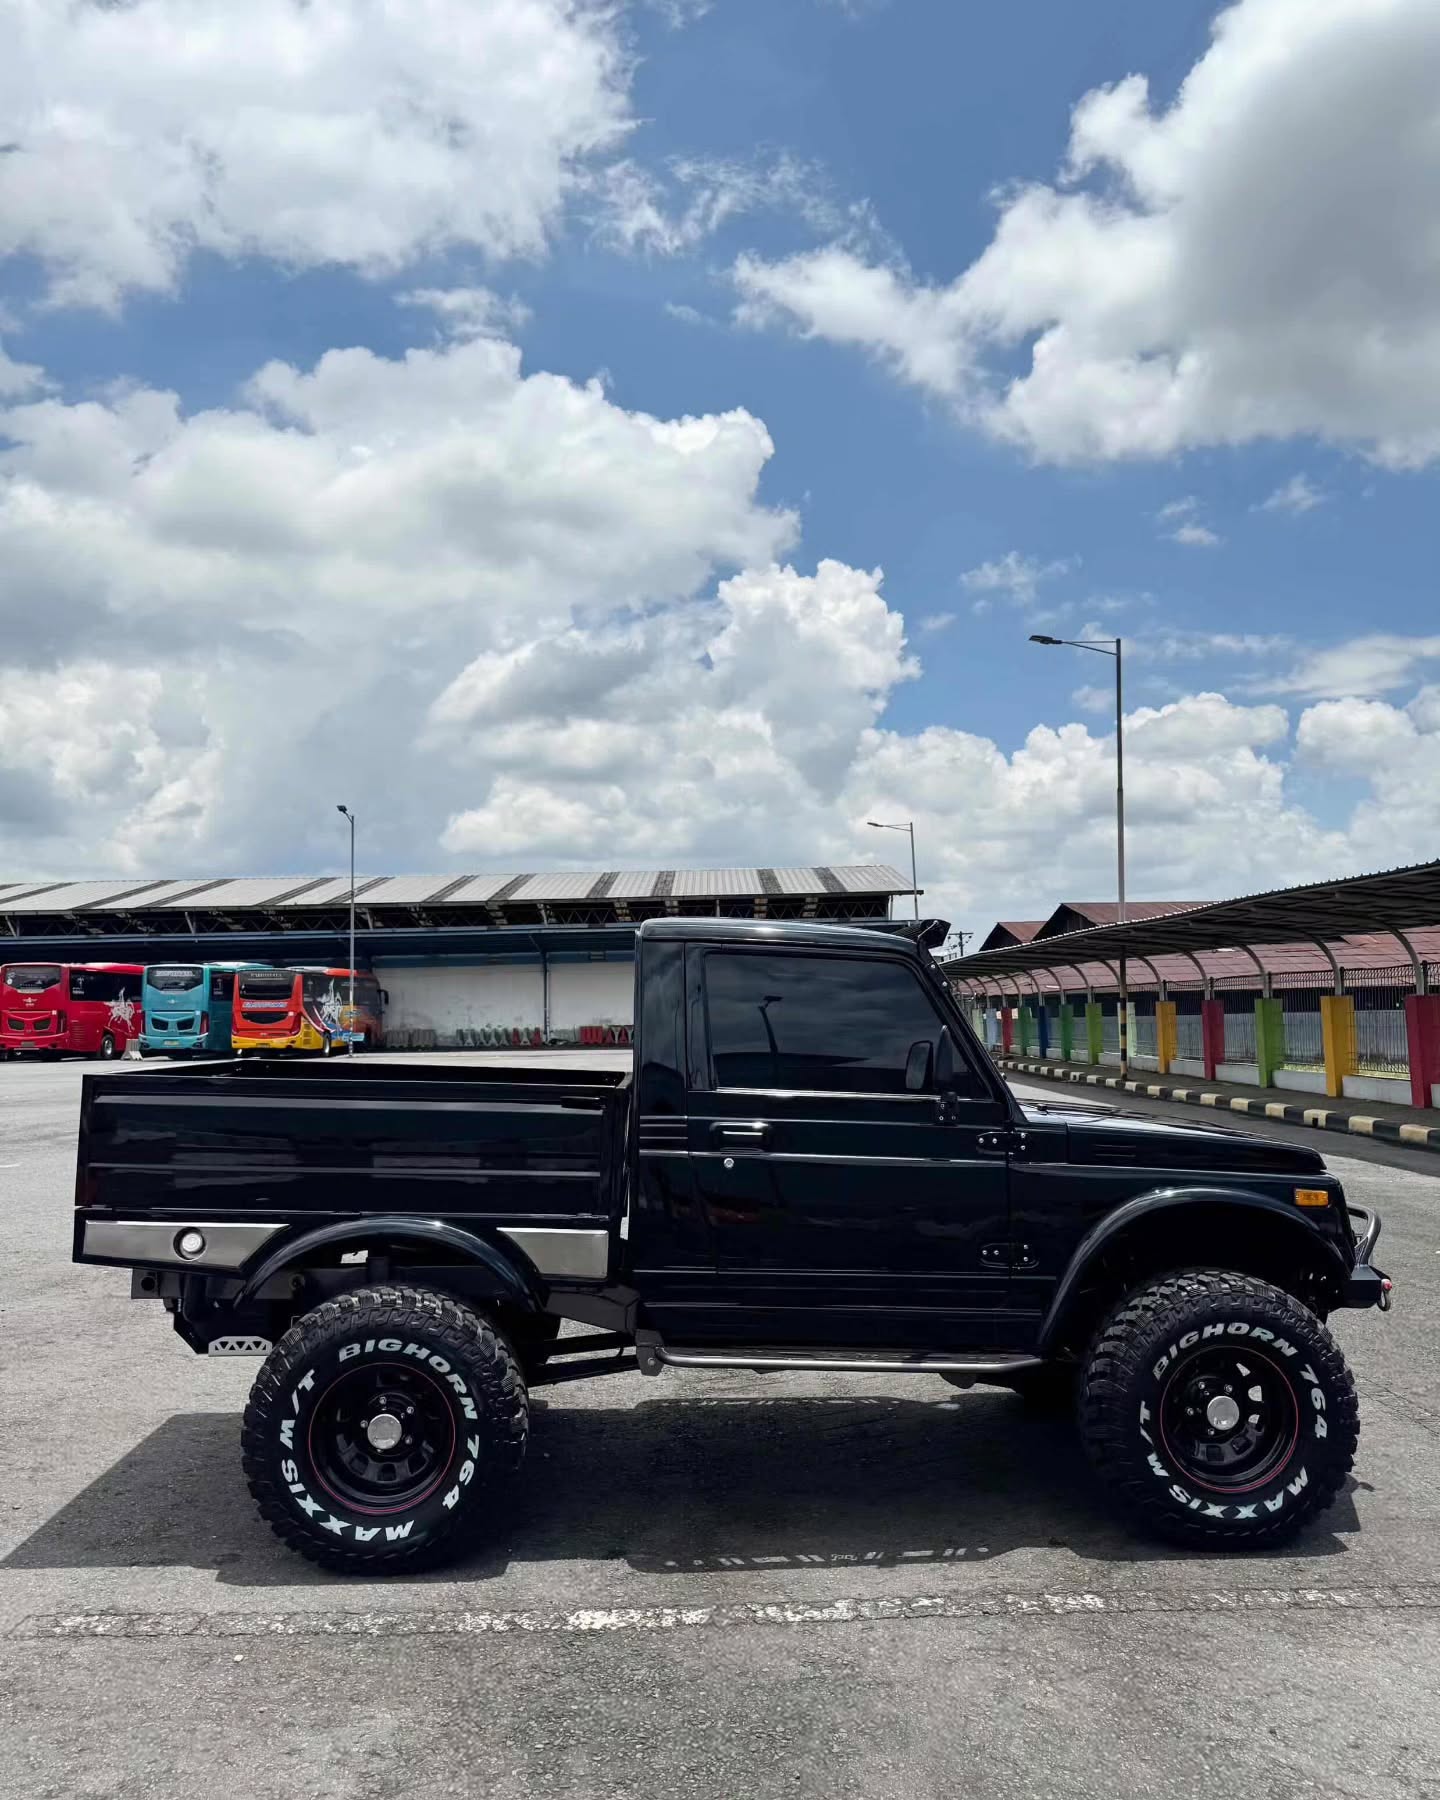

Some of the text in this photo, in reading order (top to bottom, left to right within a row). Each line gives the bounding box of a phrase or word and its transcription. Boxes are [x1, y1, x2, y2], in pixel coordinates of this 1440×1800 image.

[338, 1338, 480, 1510] BIGHORN 764
[1153, 1322, 1328, 1439] BIGHORN 764
[281, 1458, 415, 1542] MAXXIS
[1168, 1466, 1309, 1519] MAXXIS
